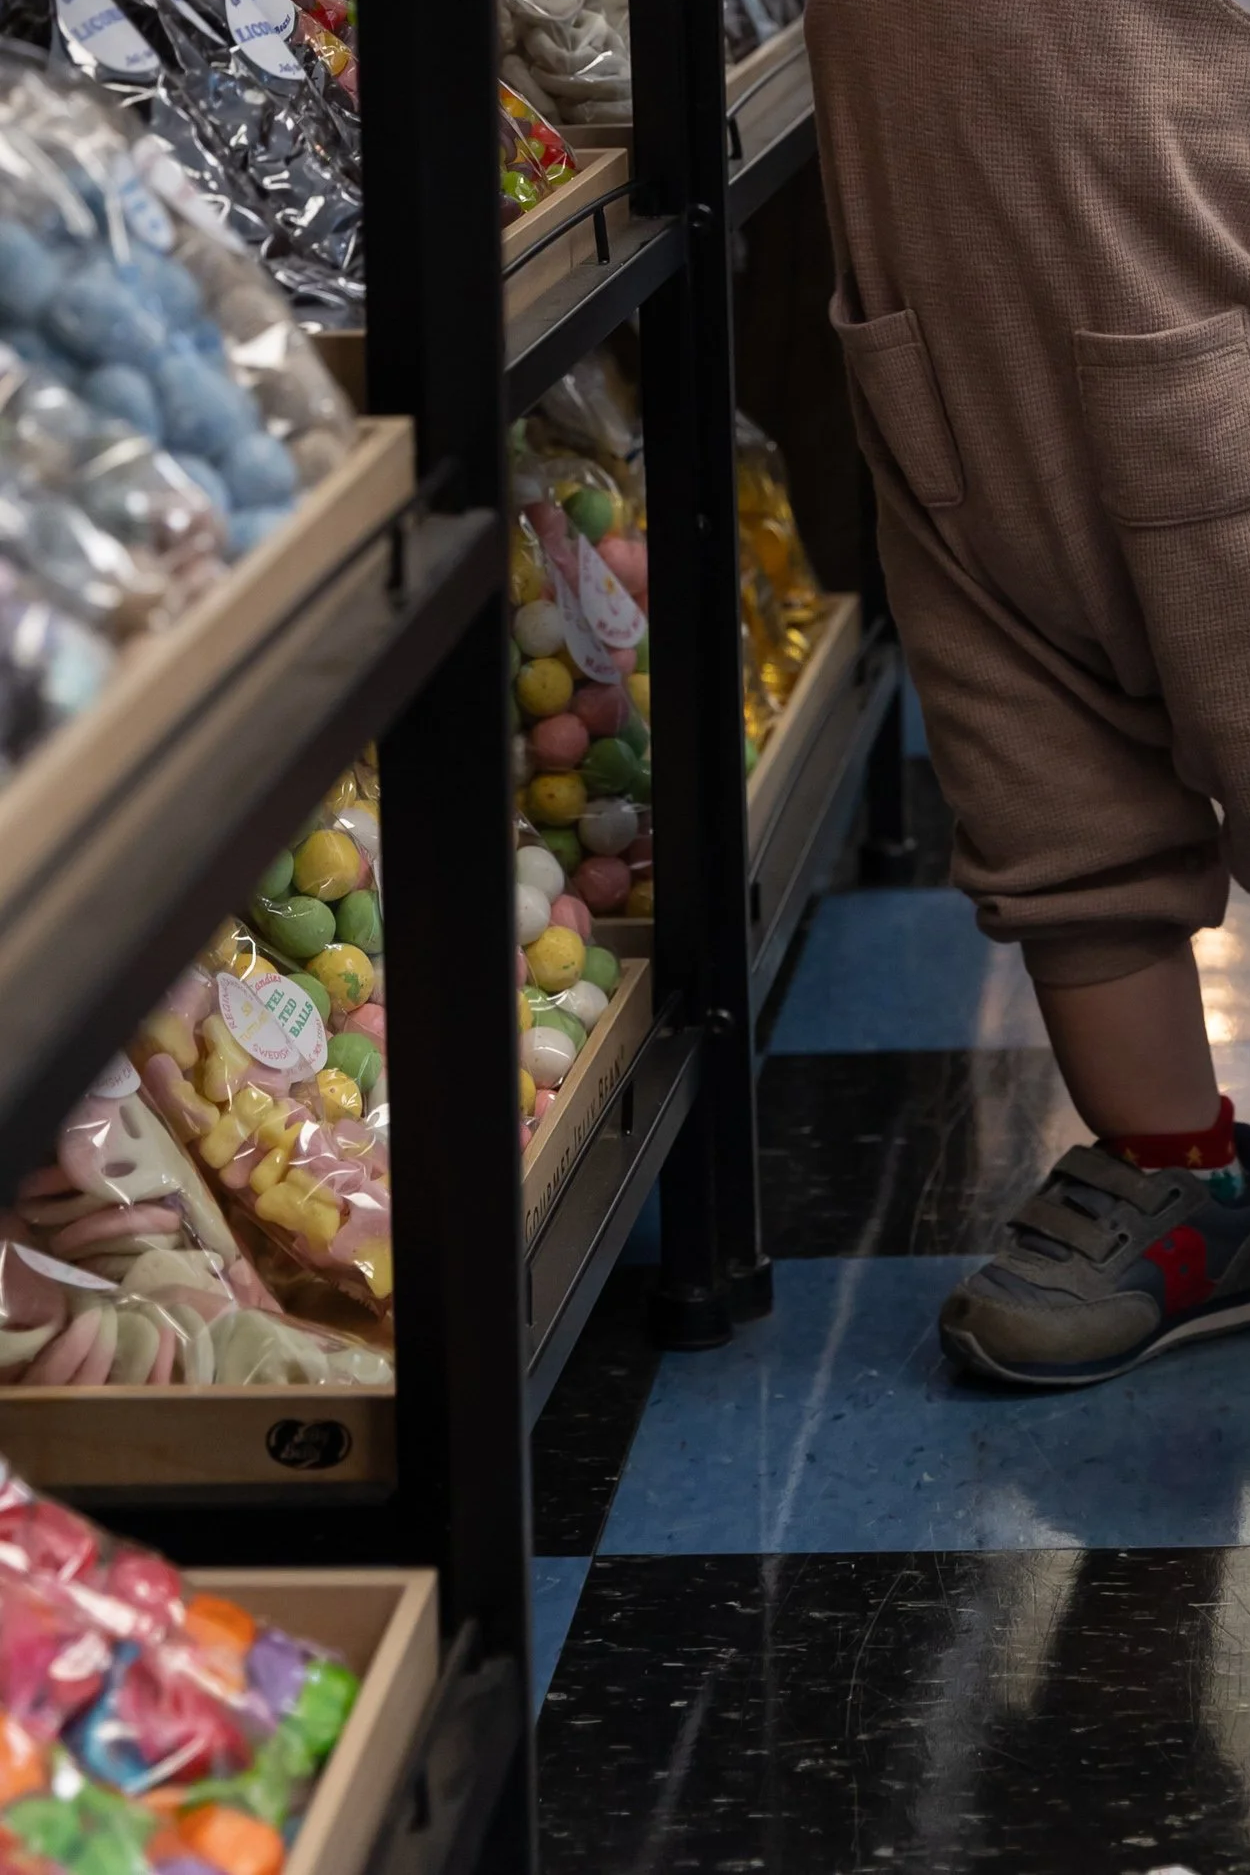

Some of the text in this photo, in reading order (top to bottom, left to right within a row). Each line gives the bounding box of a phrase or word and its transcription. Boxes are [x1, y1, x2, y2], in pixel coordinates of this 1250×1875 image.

[254, 972, 282, 992] andies
[265, 989, 285, 1012] TEL
[278, 998, 298, 1023] TED
